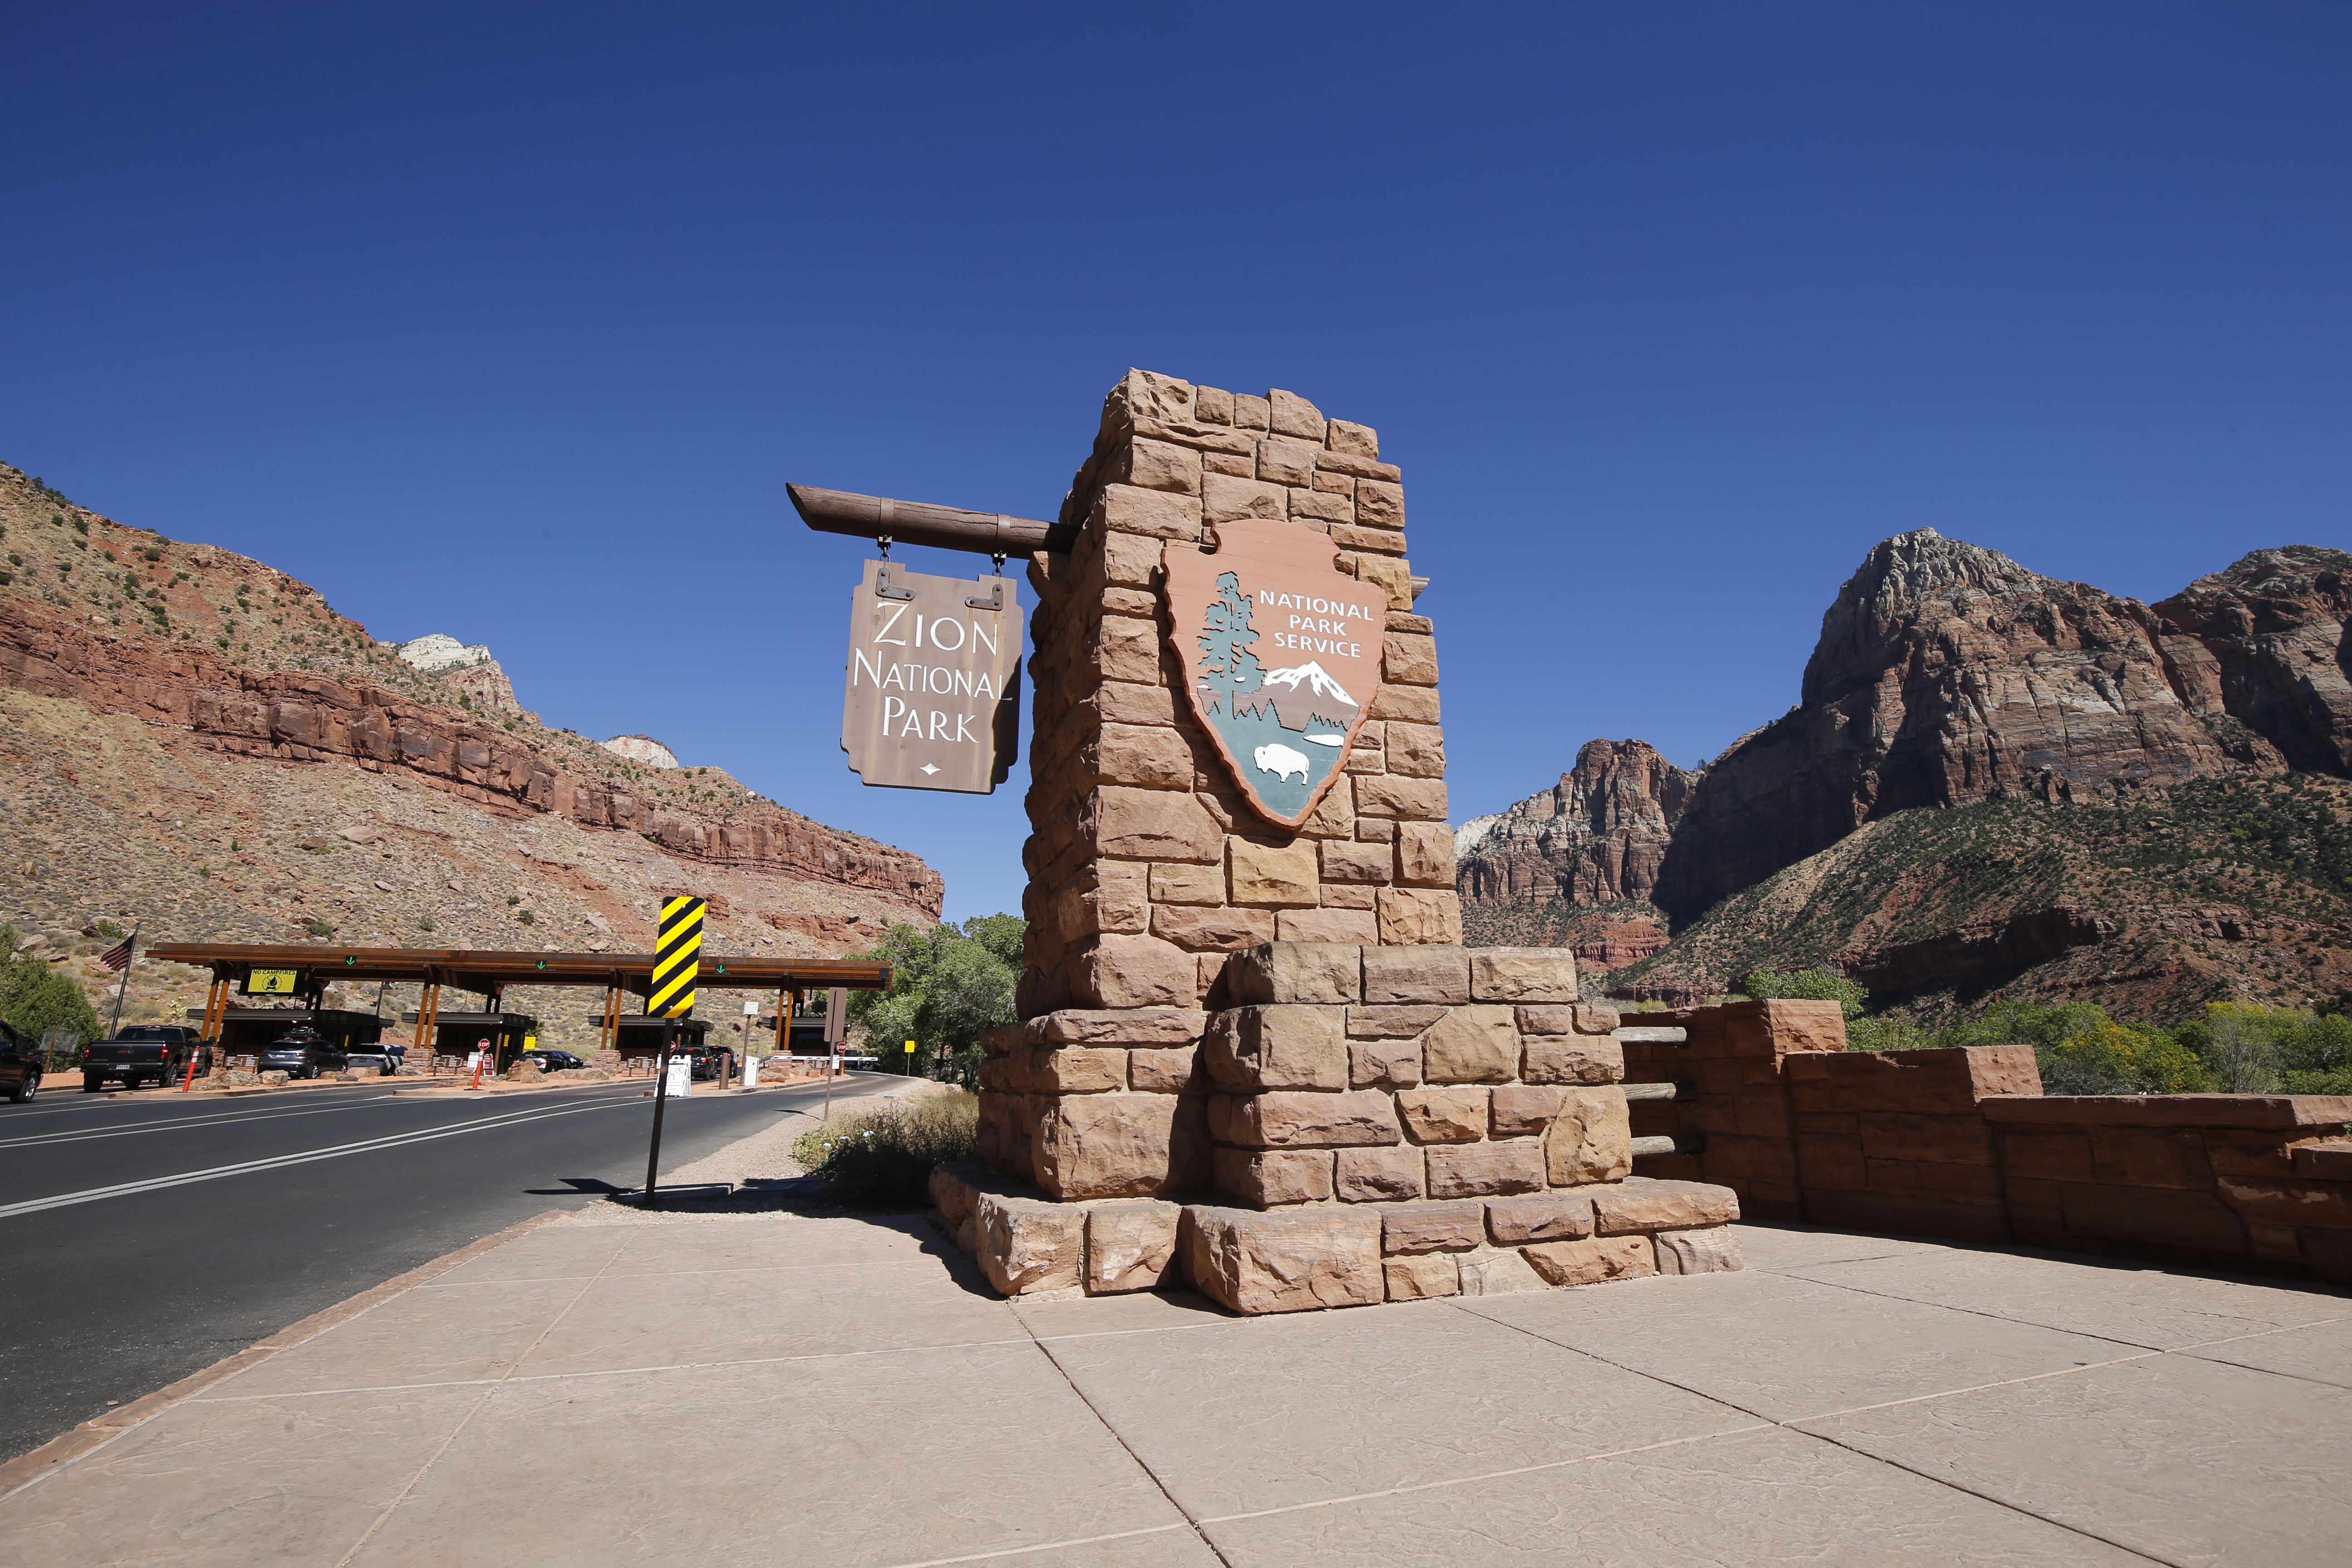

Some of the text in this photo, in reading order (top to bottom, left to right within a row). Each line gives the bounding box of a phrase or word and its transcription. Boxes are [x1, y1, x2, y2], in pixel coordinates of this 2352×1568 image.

[1260, 589, 1374, 621] NATIONAL
[1289, 613, 1348, 636] PARK
[873, 601, 998, 656] ZION
[1274, 632, 1362, 658] SERVICE
[853, 647, 1013, 701] NATIONAL
[882, 696, 980, 743] PARK
